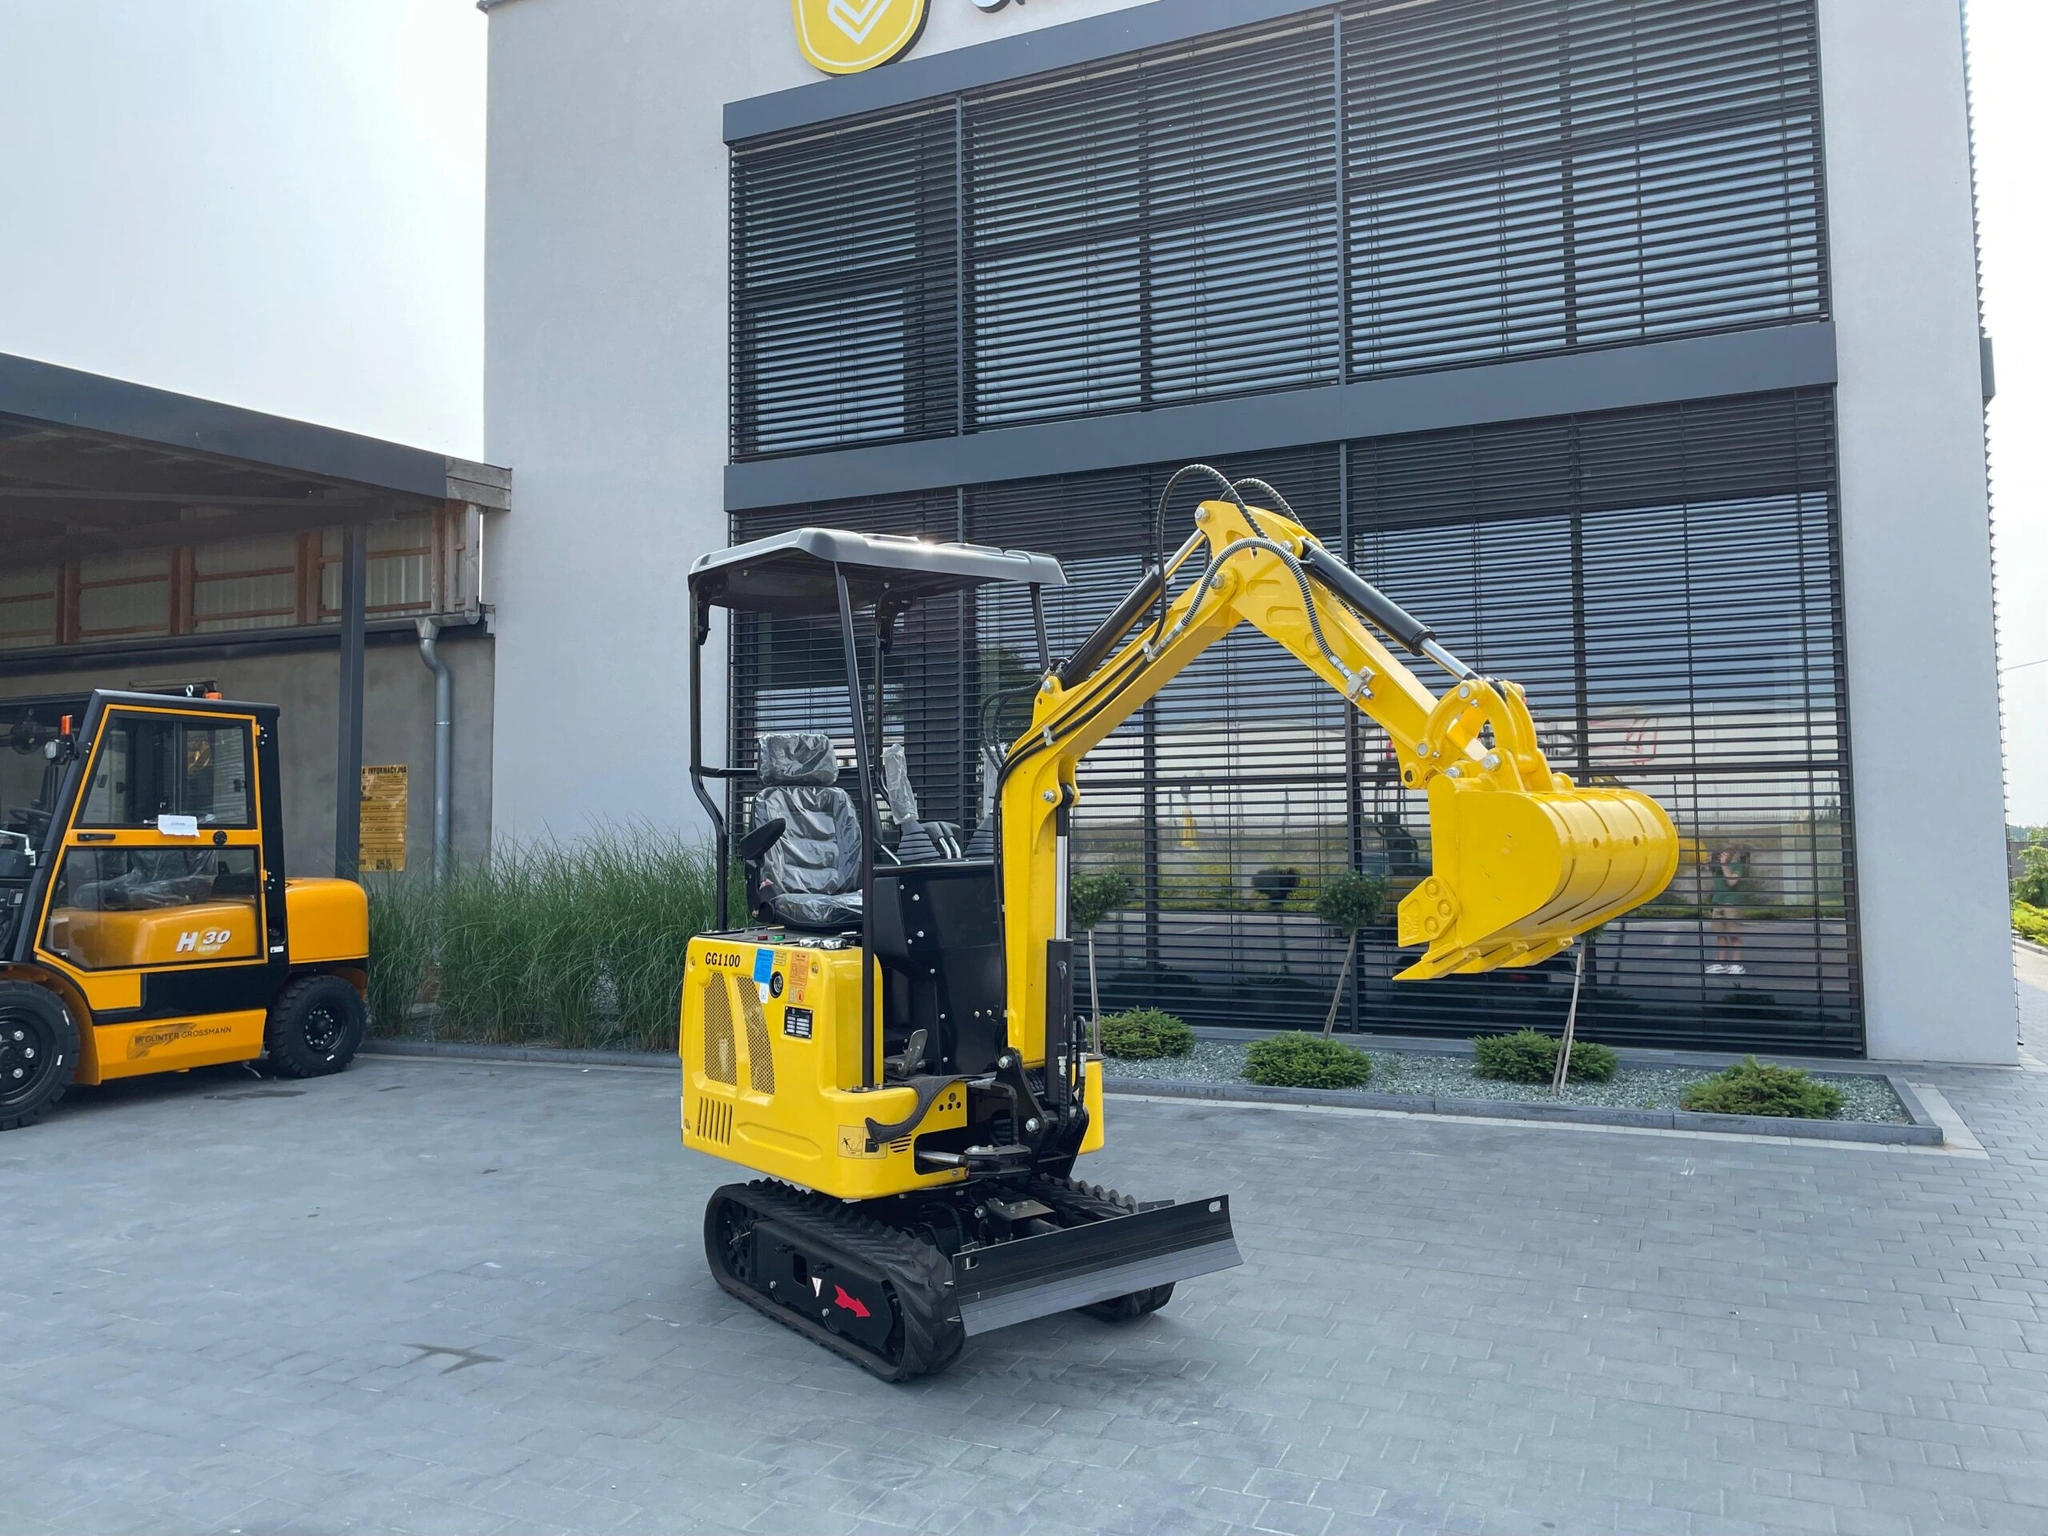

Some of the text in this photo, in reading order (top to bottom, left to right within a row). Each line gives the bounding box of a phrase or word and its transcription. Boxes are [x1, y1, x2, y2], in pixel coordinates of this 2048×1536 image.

[176, 930, 231, 953] H 30
[705, 951, 741, 968] GG1100
[181, 1026, 232, 1038] GROSSMANN
